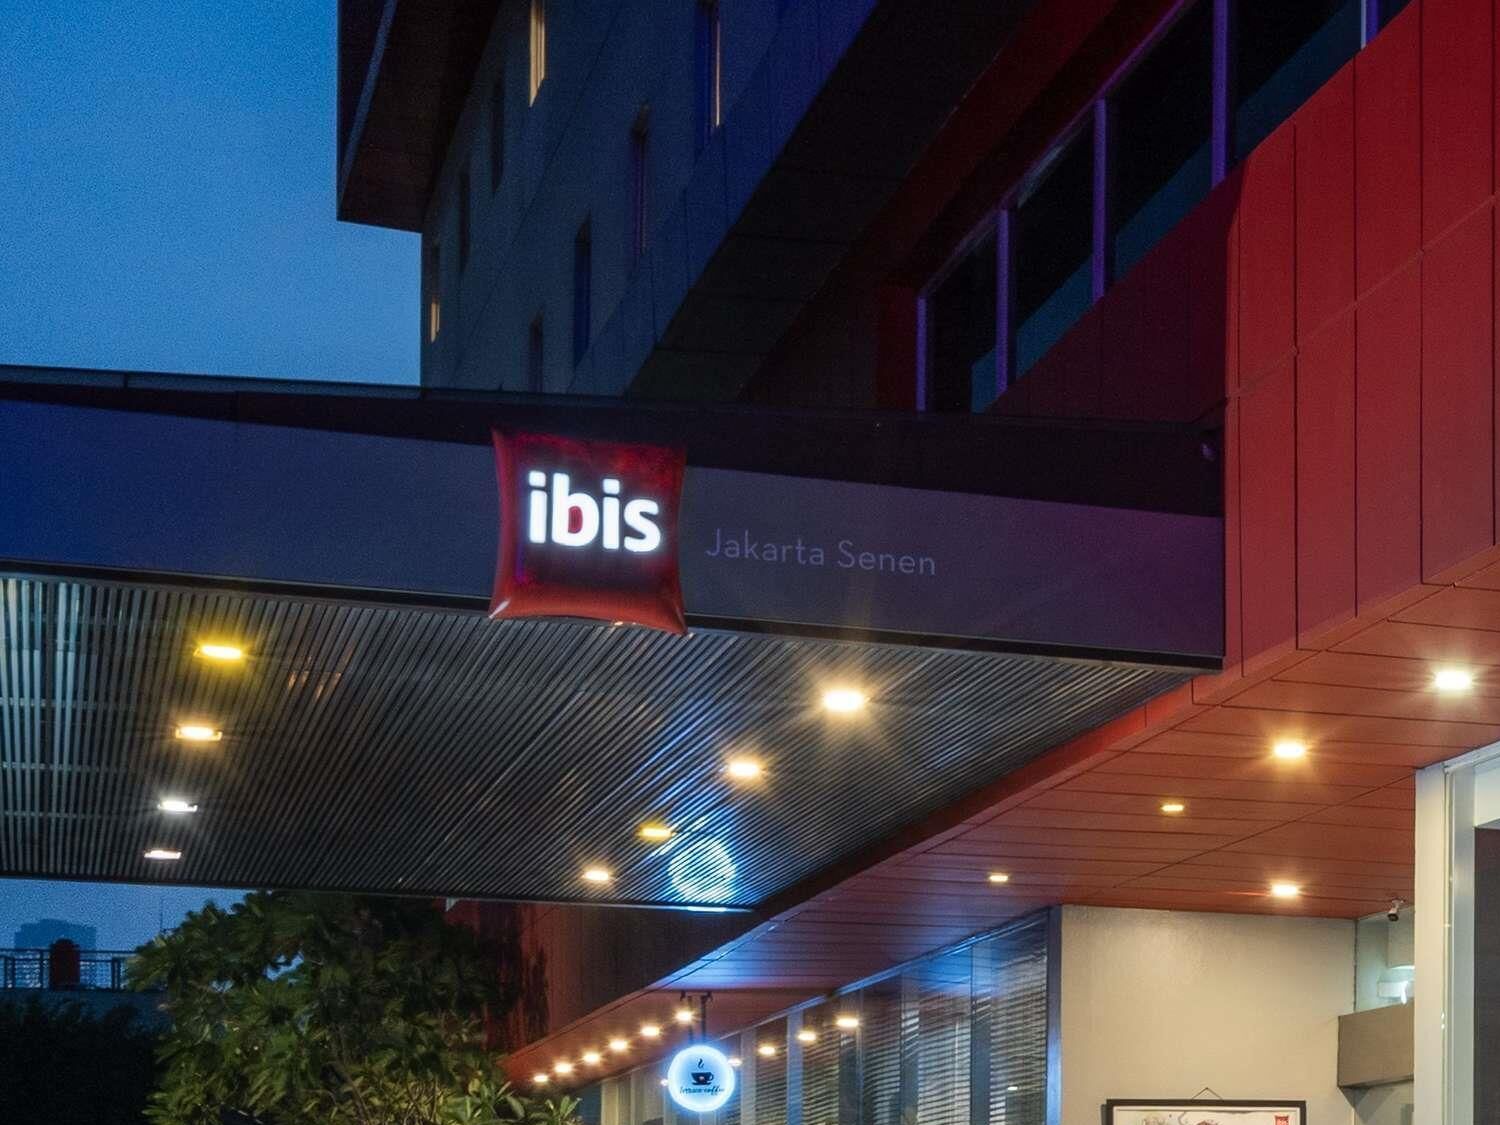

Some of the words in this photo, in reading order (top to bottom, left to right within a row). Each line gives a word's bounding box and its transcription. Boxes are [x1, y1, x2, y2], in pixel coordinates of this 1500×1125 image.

[527, 469, 663, 554] ibis
[705, 528, 826, 567] Jakarta
[837, 541, 938, 576] Senen
